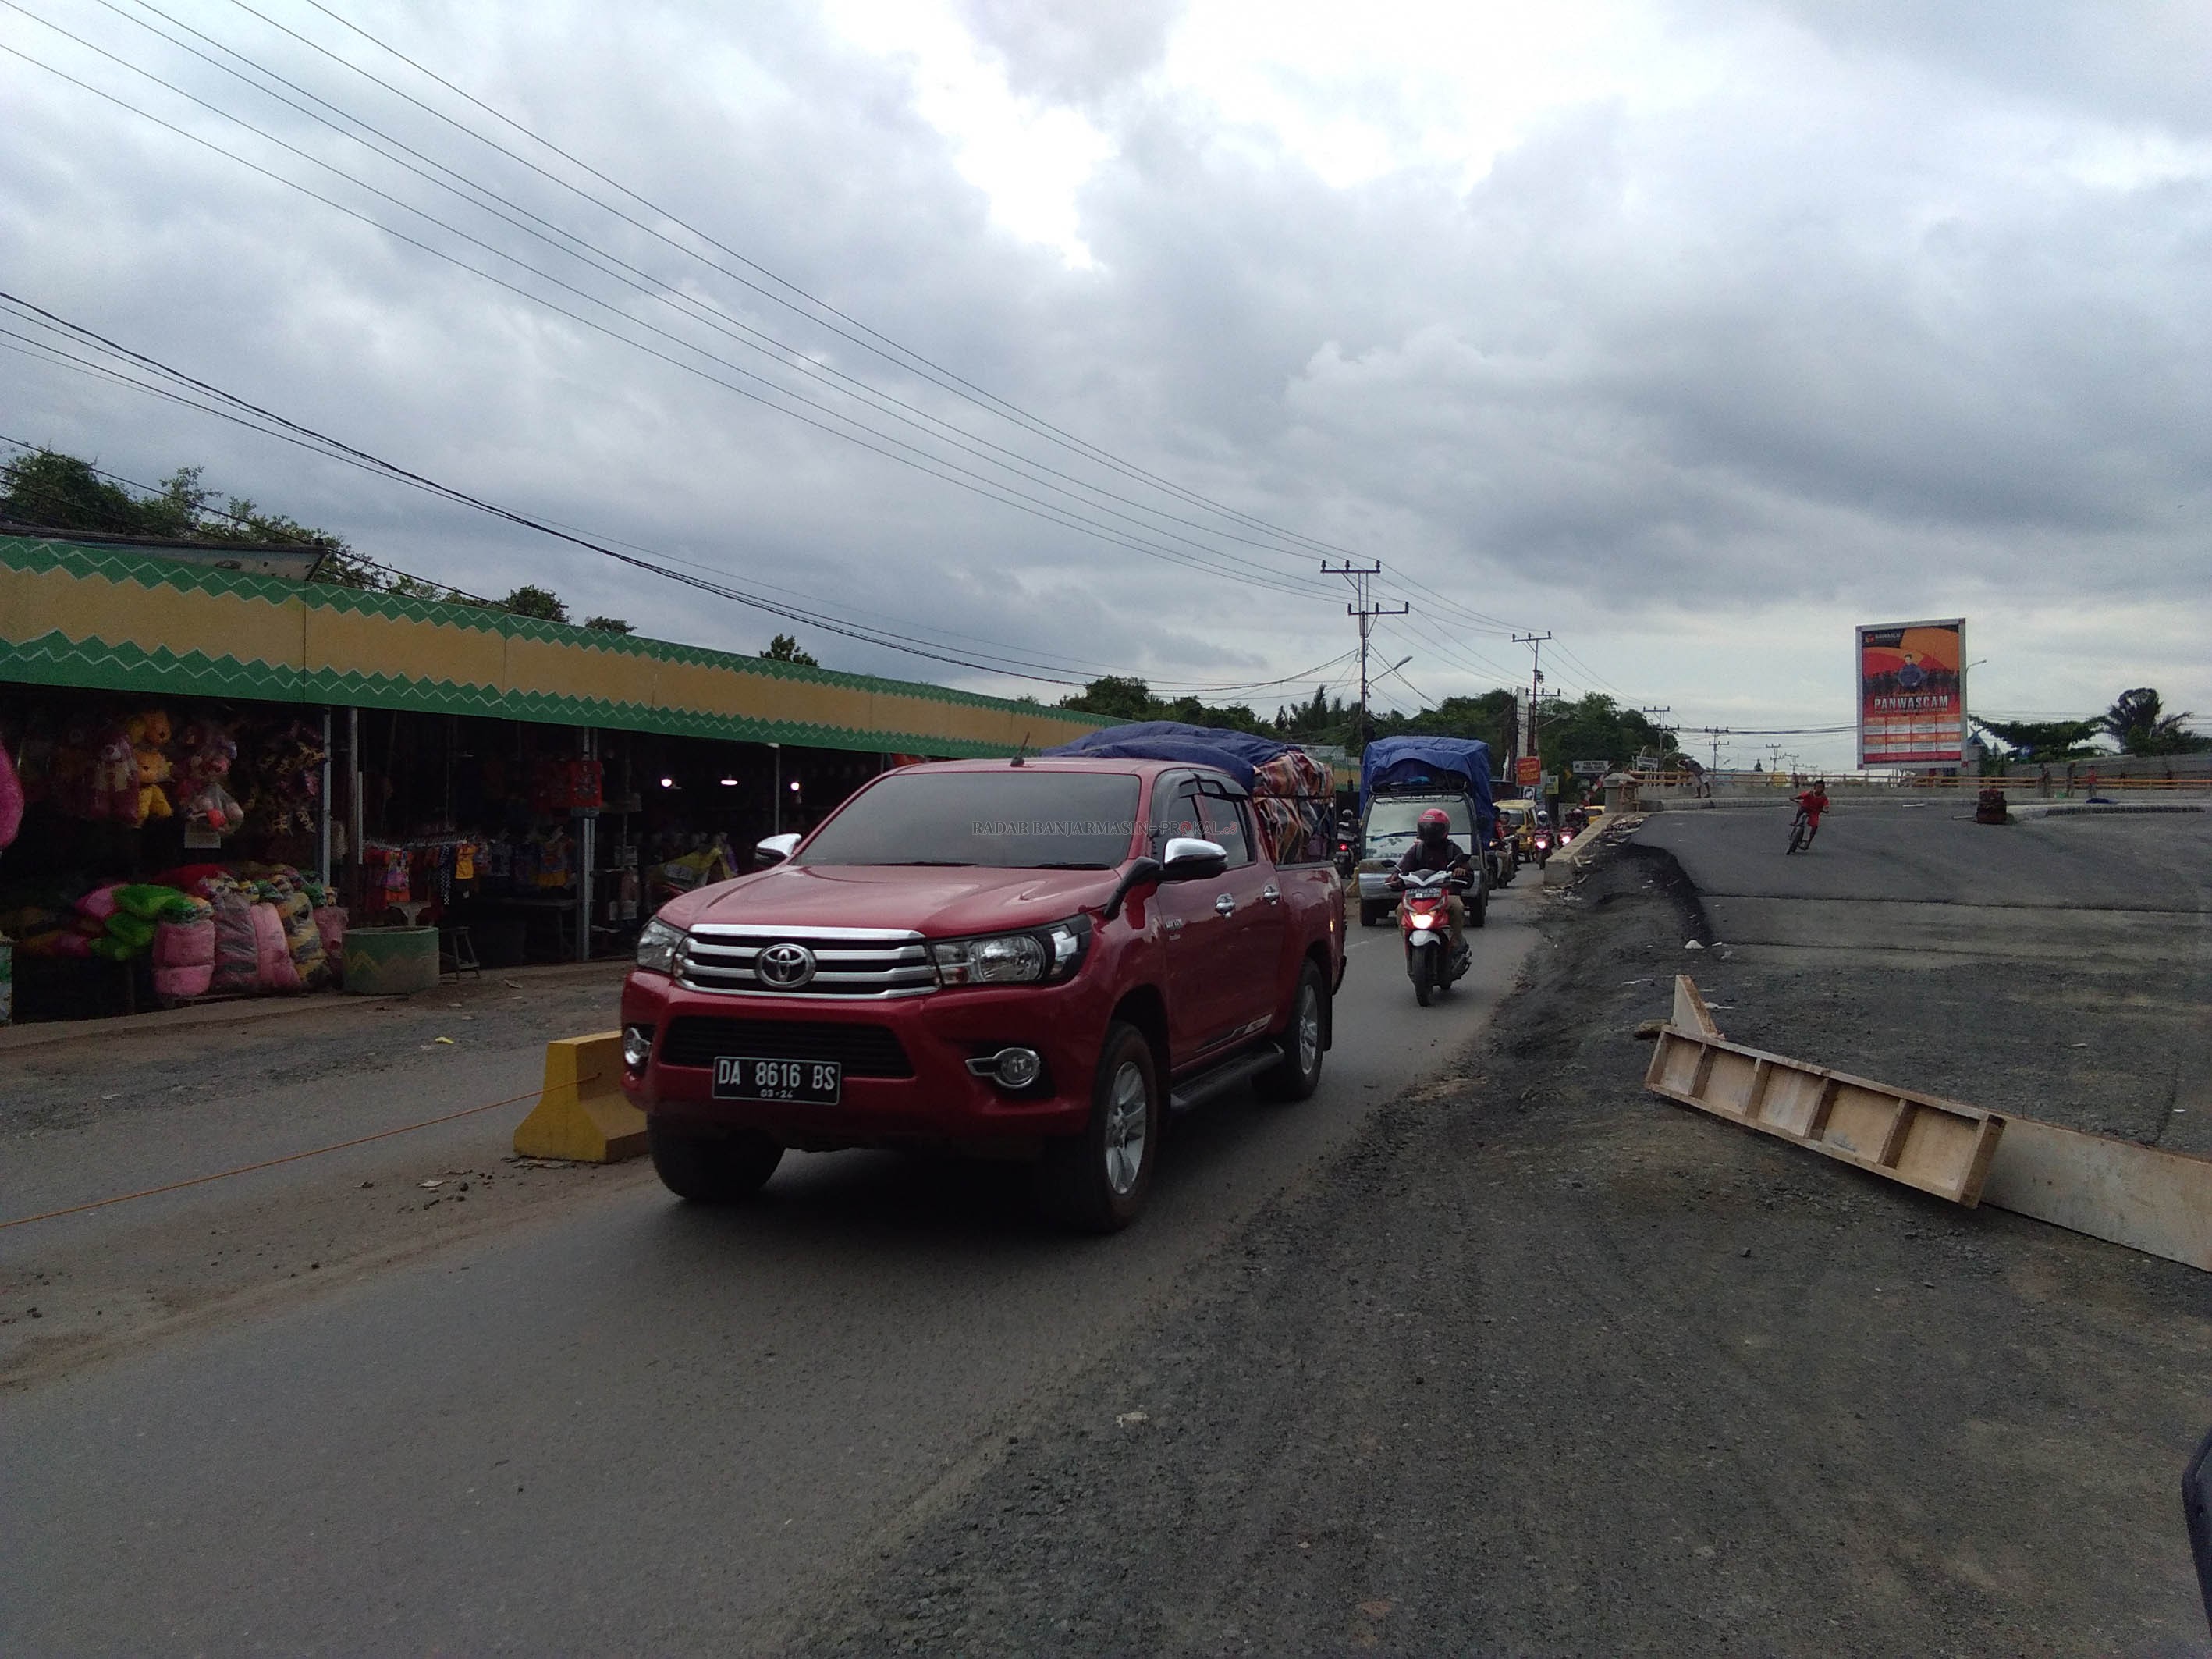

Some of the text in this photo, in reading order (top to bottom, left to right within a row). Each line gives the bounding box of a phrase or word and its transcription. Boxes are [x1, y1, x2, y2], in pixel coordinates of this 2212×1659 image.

[1874, 695, 1948, 709] PANWASCAM
[718, 1060, 836, 1091] DA 8616 BS
